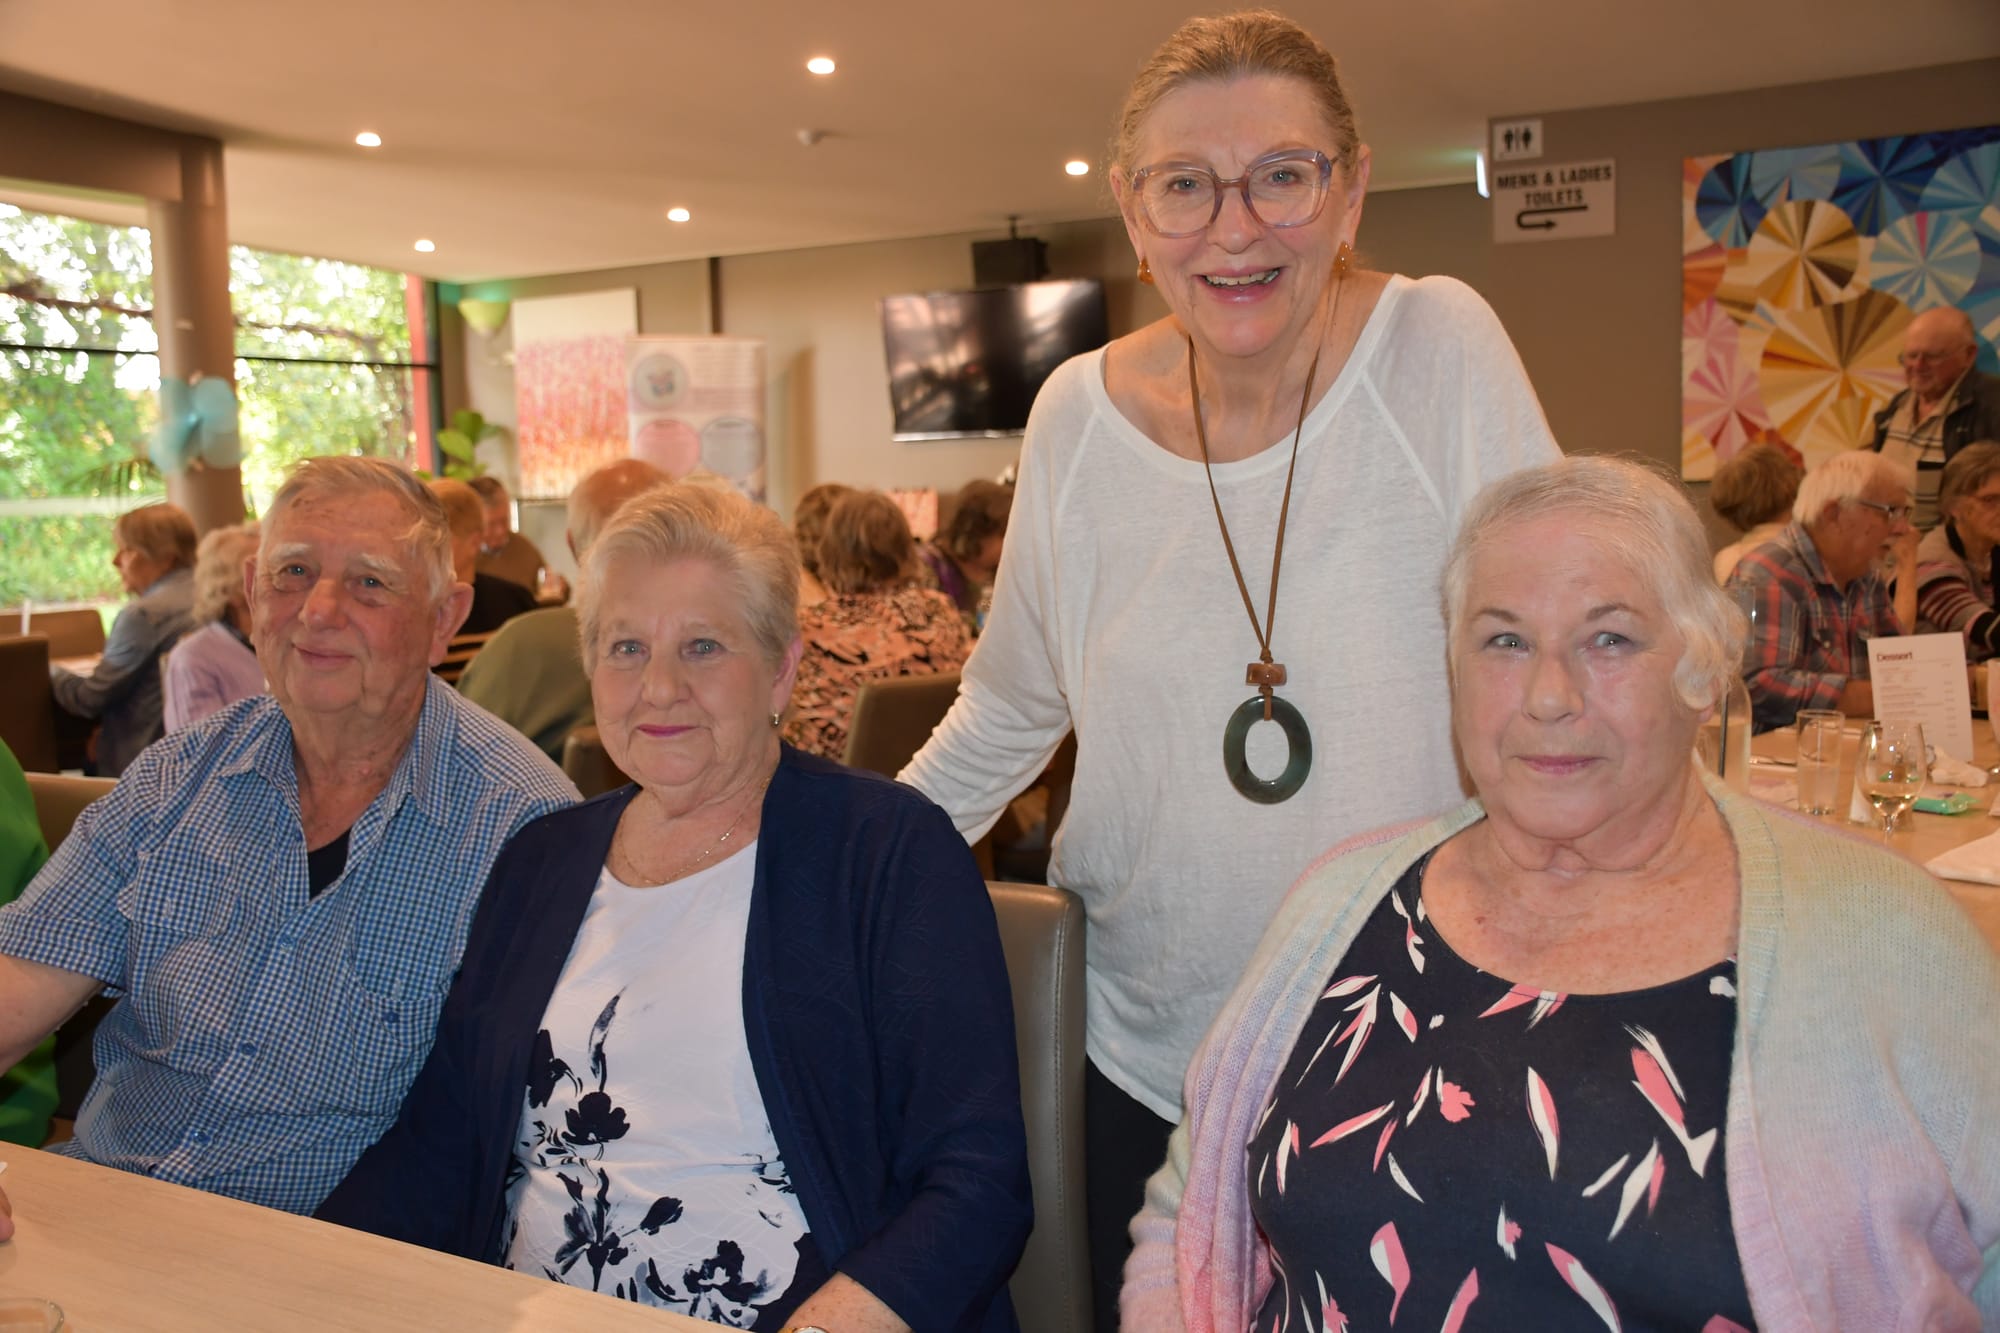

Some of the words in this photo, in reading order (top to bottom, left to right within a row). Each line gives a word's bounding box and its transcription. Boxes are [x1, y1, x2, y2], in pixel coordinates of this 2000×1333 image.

[1497, 173, 1538, 189] MENS
[1544, 171, 1554, 186] &
[1560, 166, 1612, 184] LADIES
[1525, 189, 1583, 206] TOILETS
[1876, 651, 1913, 662] Dessert
